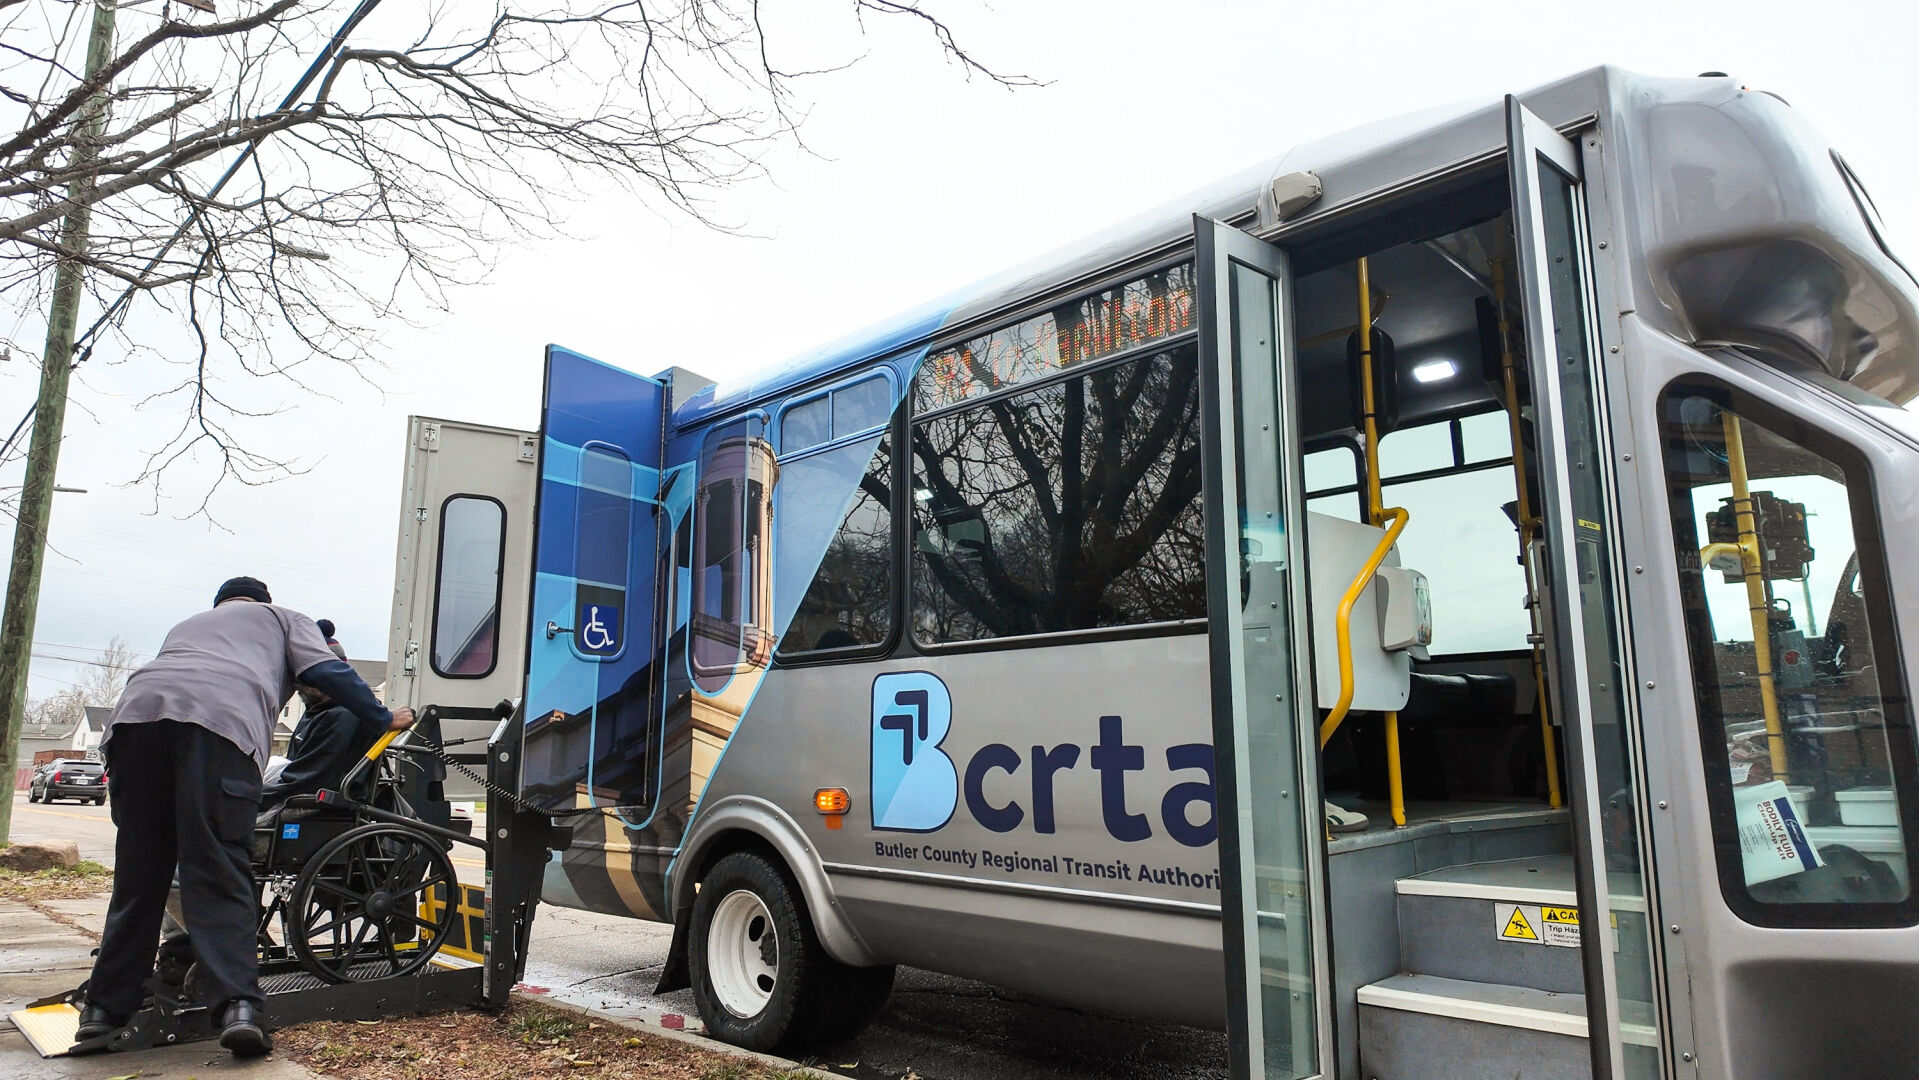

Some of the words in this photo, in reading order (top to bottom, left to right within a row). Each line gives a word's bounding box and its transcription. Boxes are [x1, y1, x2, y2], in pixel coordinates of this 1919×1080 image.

[1034, 288, 1190, 370] Hamilton
[1757, 803, 1778, 845] Clean-Up
[1776, 846, 1787, 861] Kit
[1762, 800, 1784, 832] BODILY
[1778, 833, 1795, 859] FLUID
[874, 841, 918, 860] Butler
[922, 845, 978, 869] County
[982, 850, 1058, 873] Regional
[1063, 857, 1132, 881] Transit
[1548, 925, 1562, 933] Trip
[1564, 926, 1580, 934] Haz
